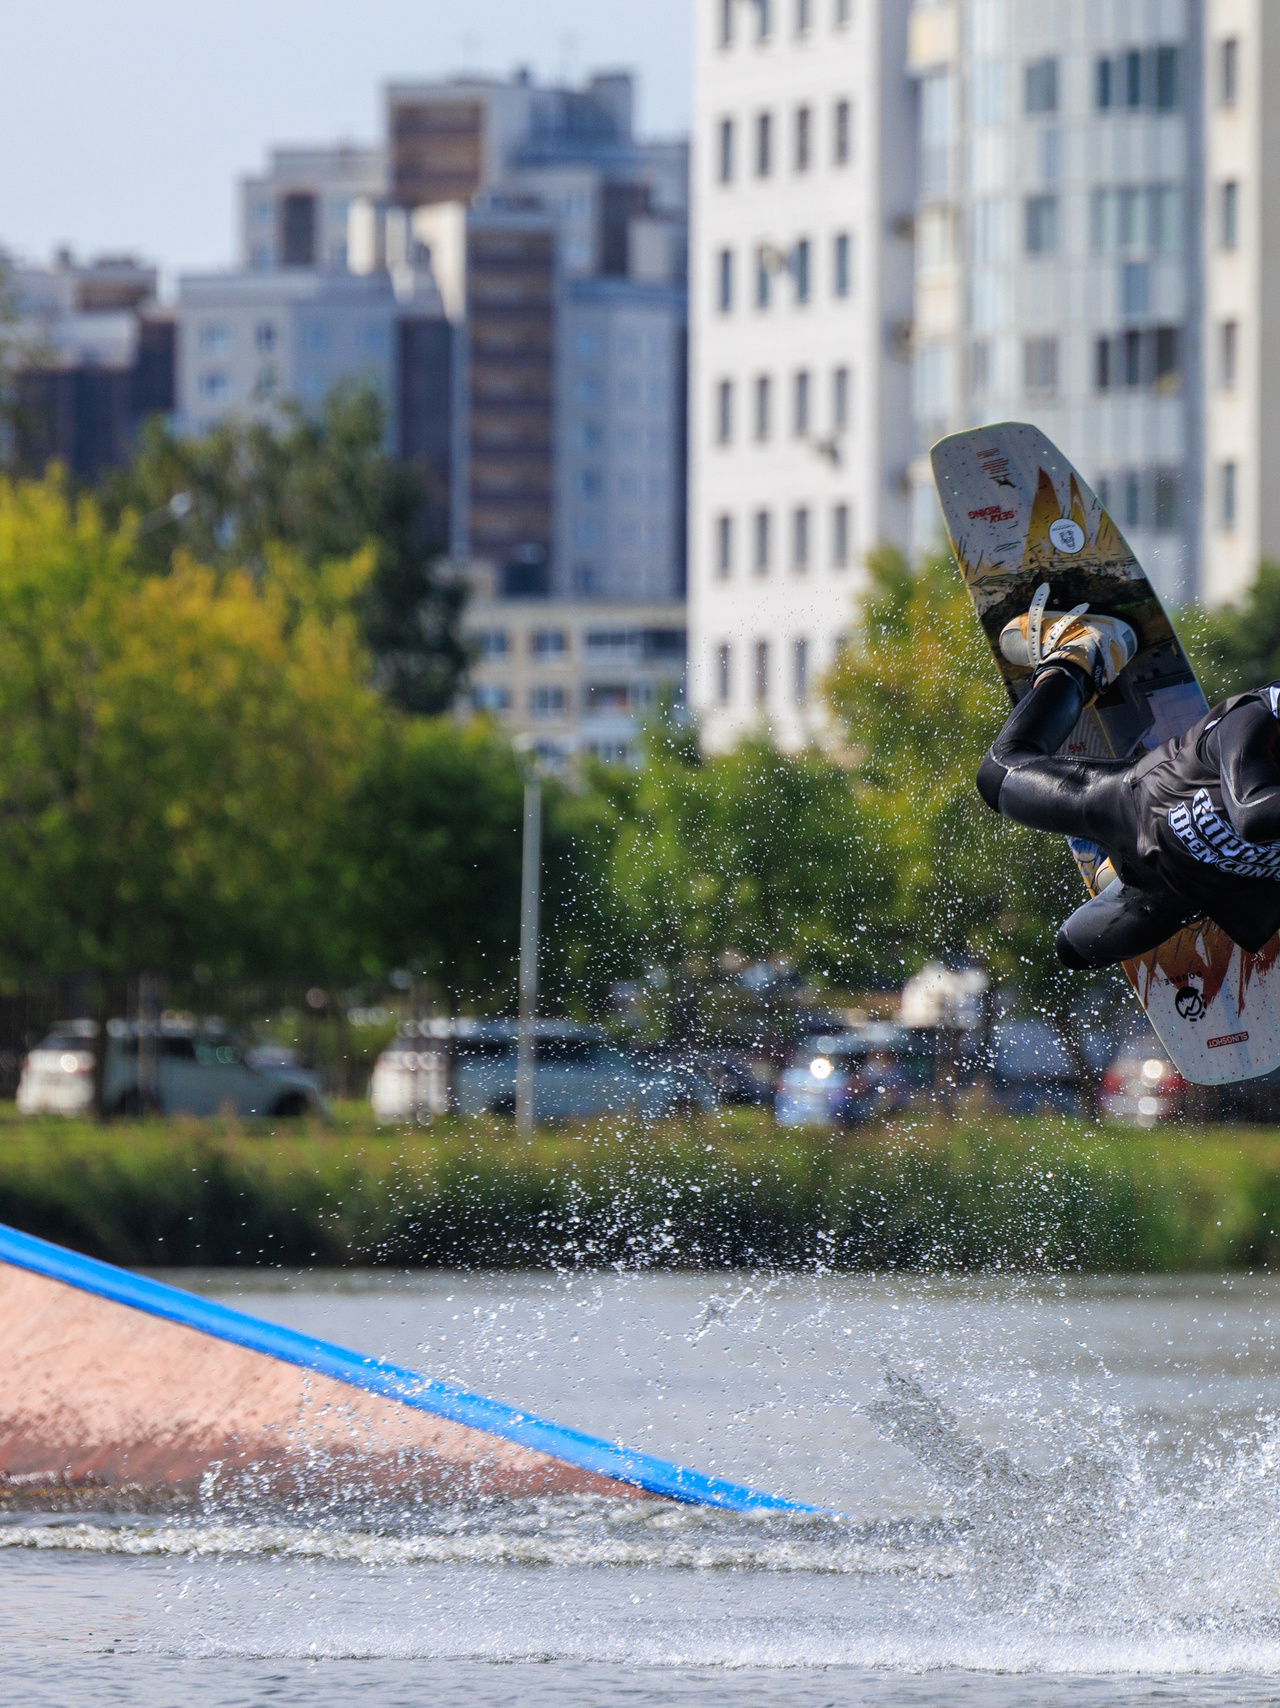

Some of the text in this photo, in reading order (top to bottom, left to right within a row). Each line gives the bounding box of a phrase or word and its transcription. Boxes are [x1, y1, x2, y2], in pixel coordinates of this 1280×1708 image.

[967, 504, 1002, 519] RIDING
[1168, 802, 1218, 863] OPEN
[1163, 970, 1202, 986] DOUBLE
[1207, 1032, 1249, 1048] SLINGSHOT
